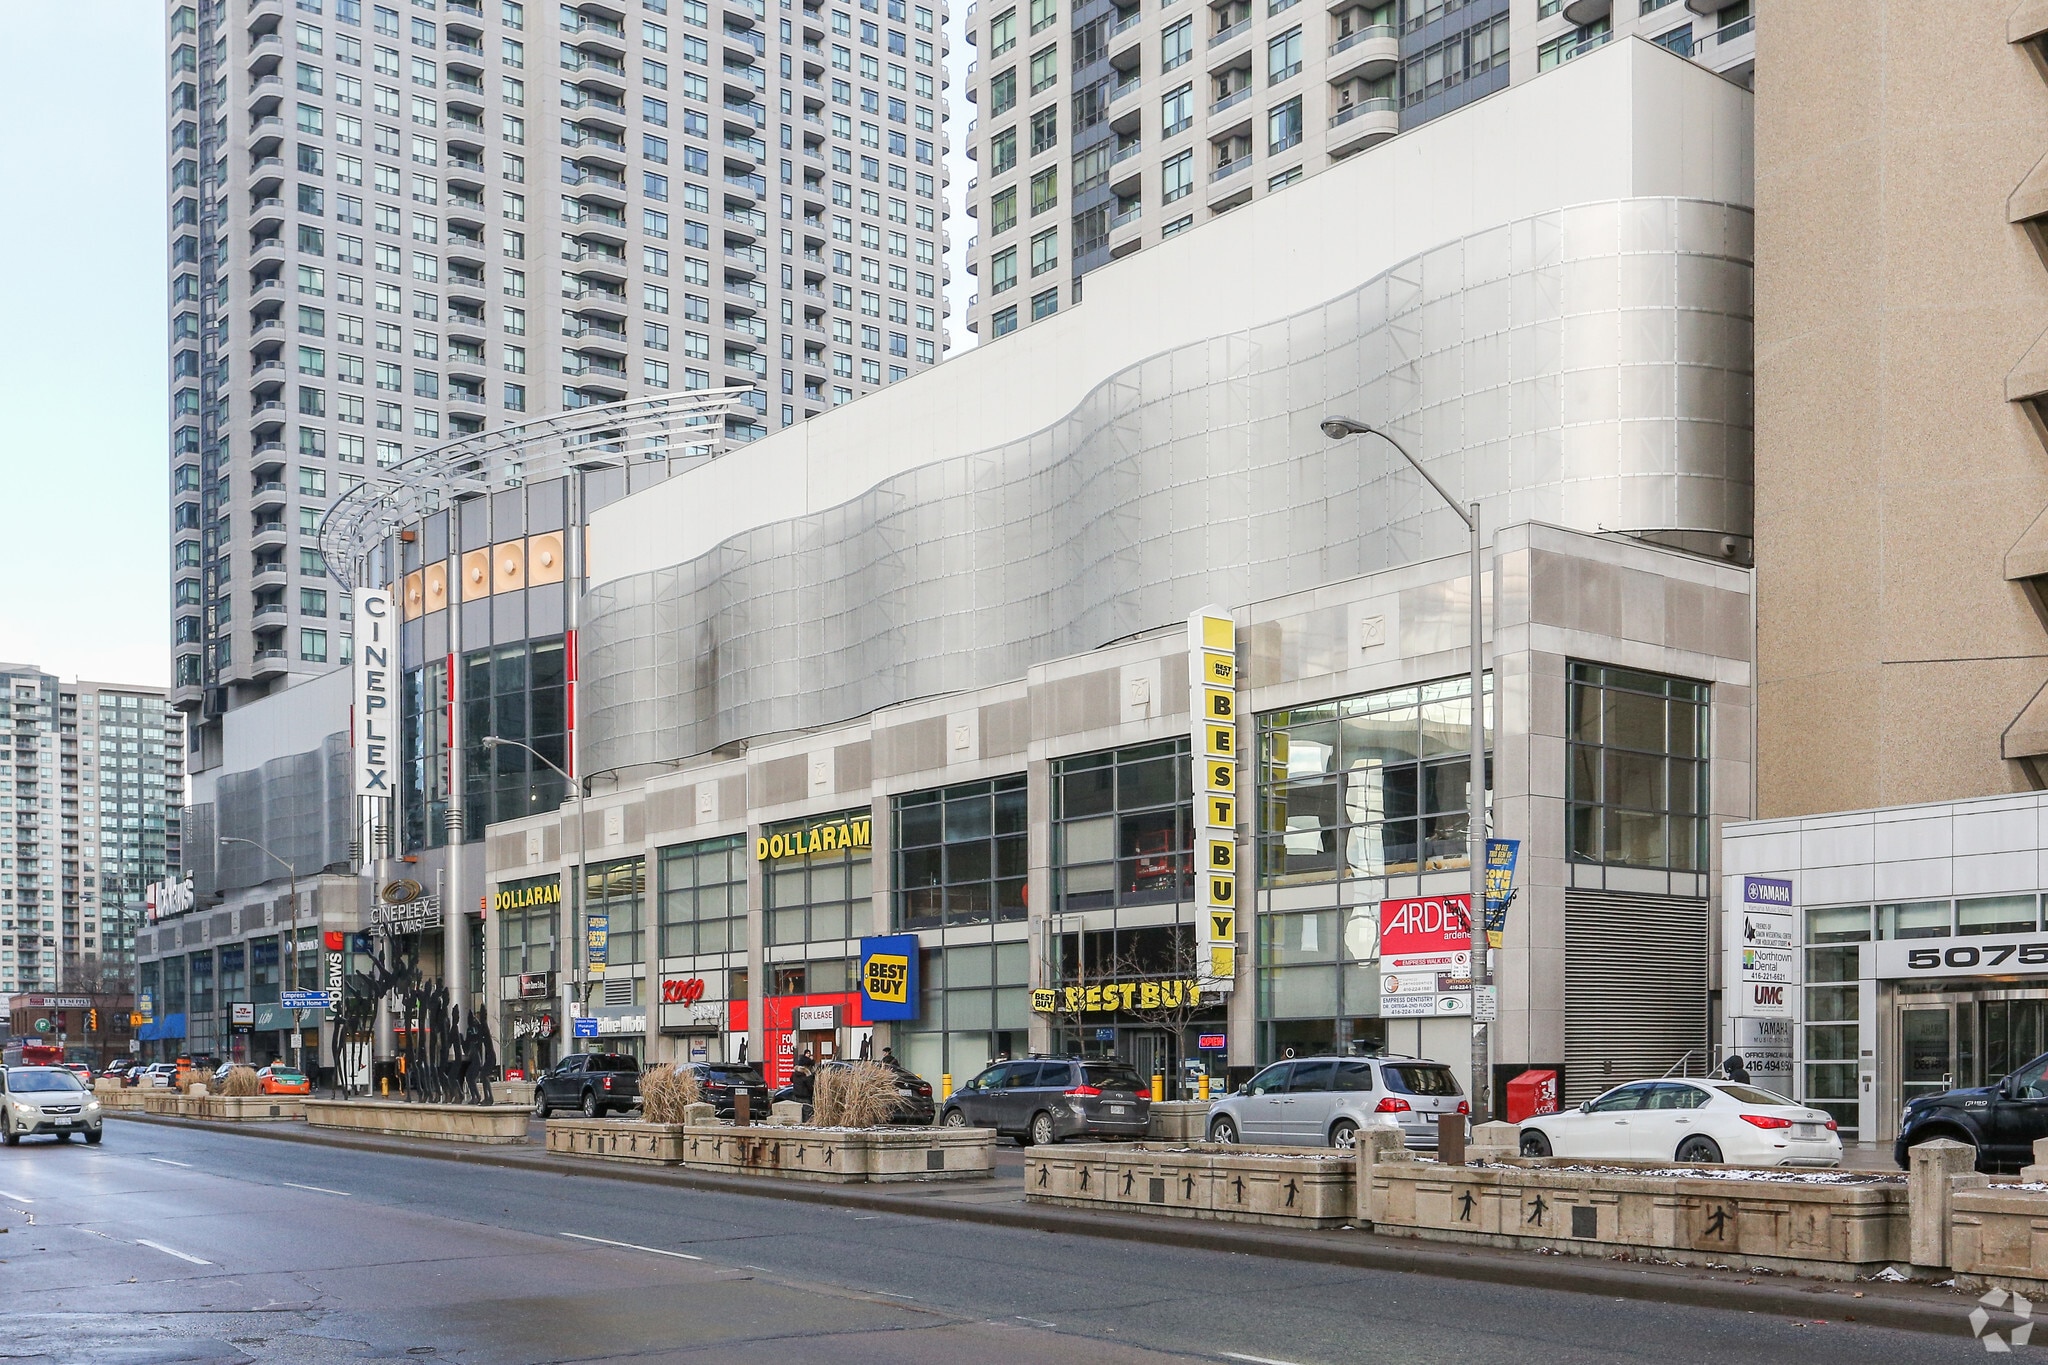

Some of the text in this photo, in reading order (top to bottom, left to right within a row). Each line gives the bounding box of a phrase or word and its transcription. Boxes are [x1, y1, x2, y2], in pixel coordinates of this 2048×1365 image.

[1215, 662, 1231, 671] BEST
[1215, 668, 1230, 677] BUY
[365, 597, 387, 790] CINEPLEX
[1213, 695, 1232, 823] BEST
[757, 820, 871, 861] DOLLARAM
[1212, 845, 1232, 938] BUY
[1758, 884, 1790, 902] YAMAHA
[371, 900, 430, 923] CINEPLEX
[379, 919, 421, 937] CNEMAS
[1755, 950, 1792, 962] Northtown
[1907, 942, 2048, 970] 5075
[869, 963, 906, 980] BEST
[1755, 960, 1778, 971] Dental
[870, 978, 903, 995] BUY
[1754, 984, 1783, 1005] UMC
[1035, 993, 1055, 1001] BEST
[1035, 1000, 1052, 1009] BUY
[1065, 983, 1136, 1013] BEST
[800, 1010, 832, 1020] FOR LEASE
[1759, 1022, 1788, 1035] YAMAHA
[782, 1034, 793, 1043] FO
[1200, 1036, 1224, 1047] OPEN
[1745, 1060, 1763, 1071] 416
[1764, 1060, 1780, 1071] 494
